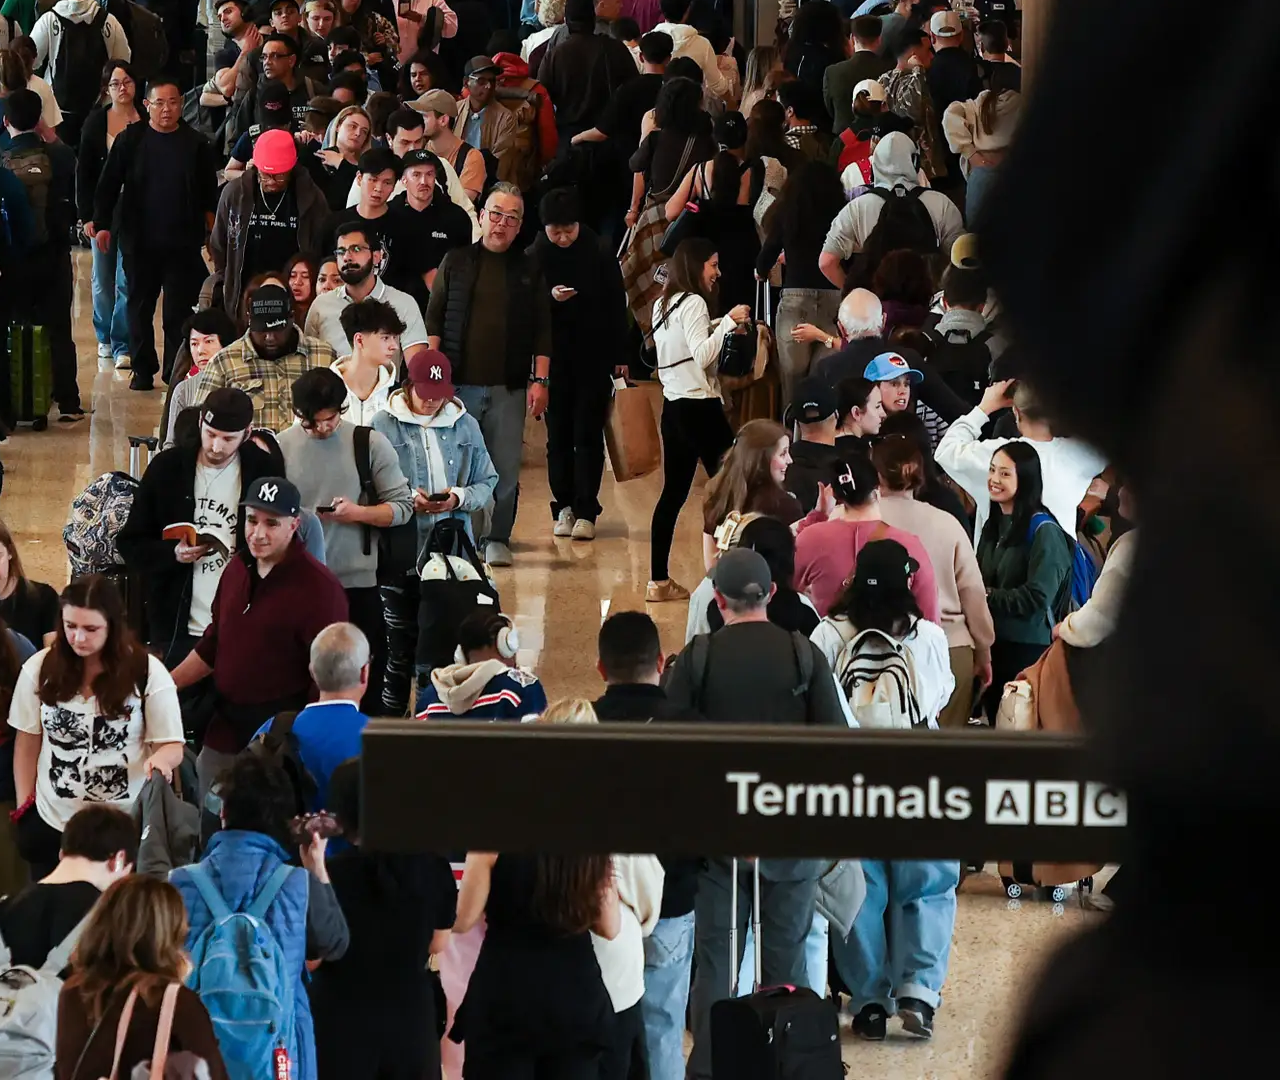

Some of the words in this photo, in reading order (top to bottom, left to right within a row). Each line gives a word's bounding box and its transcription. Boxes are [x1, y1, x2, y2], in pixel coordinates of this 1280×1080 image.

[430, 365, 443, 380] NY
[258, 482, 279, 503] NY
[726, 772, 972, 820] Terminals
